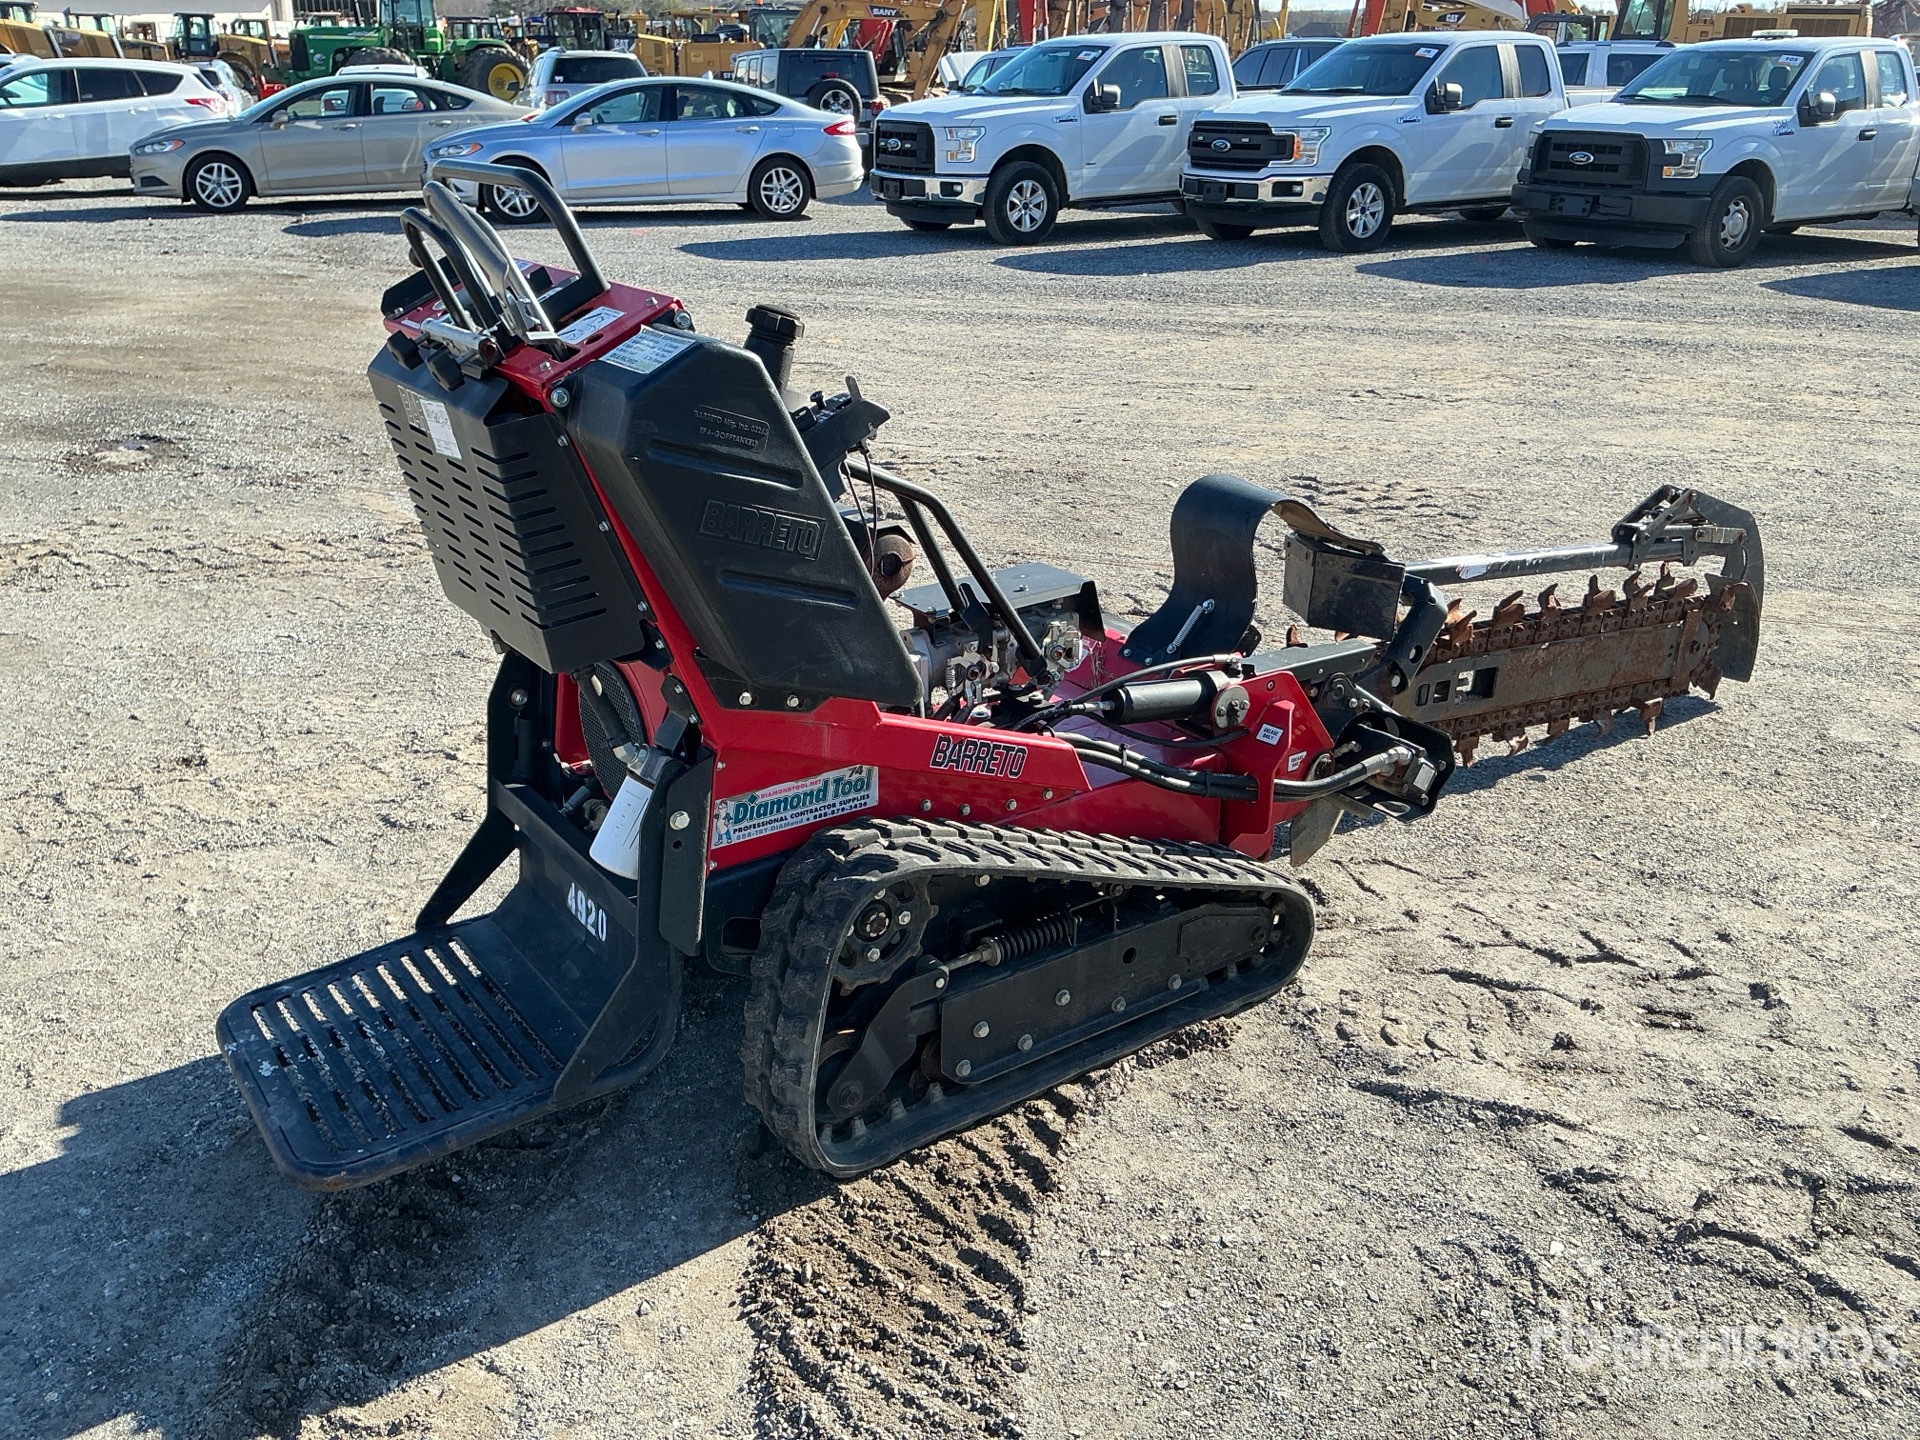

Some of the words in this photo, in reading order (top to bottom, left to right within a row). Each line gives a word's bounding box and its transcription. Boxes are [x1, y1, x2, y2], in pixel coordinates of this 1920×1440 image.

[872, 8, 897, 16] SANY
[1445, 13, 1459, 23] CAT
[613, 38, 630, 50] CAT
[700, 500, 821, 556] BARRETO
[929, 733, 1029, 779] BARRETO
[848, 765, 864, 778] 74
[732, 778, 831, 825] Diamond
[831, 767, 874, 800] Tool
[760, 779, 822, 799] DIAMONDTOOL.NET
[732, 815, 789, 834] PROFESSIONAL
[790, 803, 837, 819] CONTRACTOR
[838, 793, 870, 807] SUPPLIES
[813, 801, 868, 820] 888-879-3426
[567, 882, 607, 942] 4920
